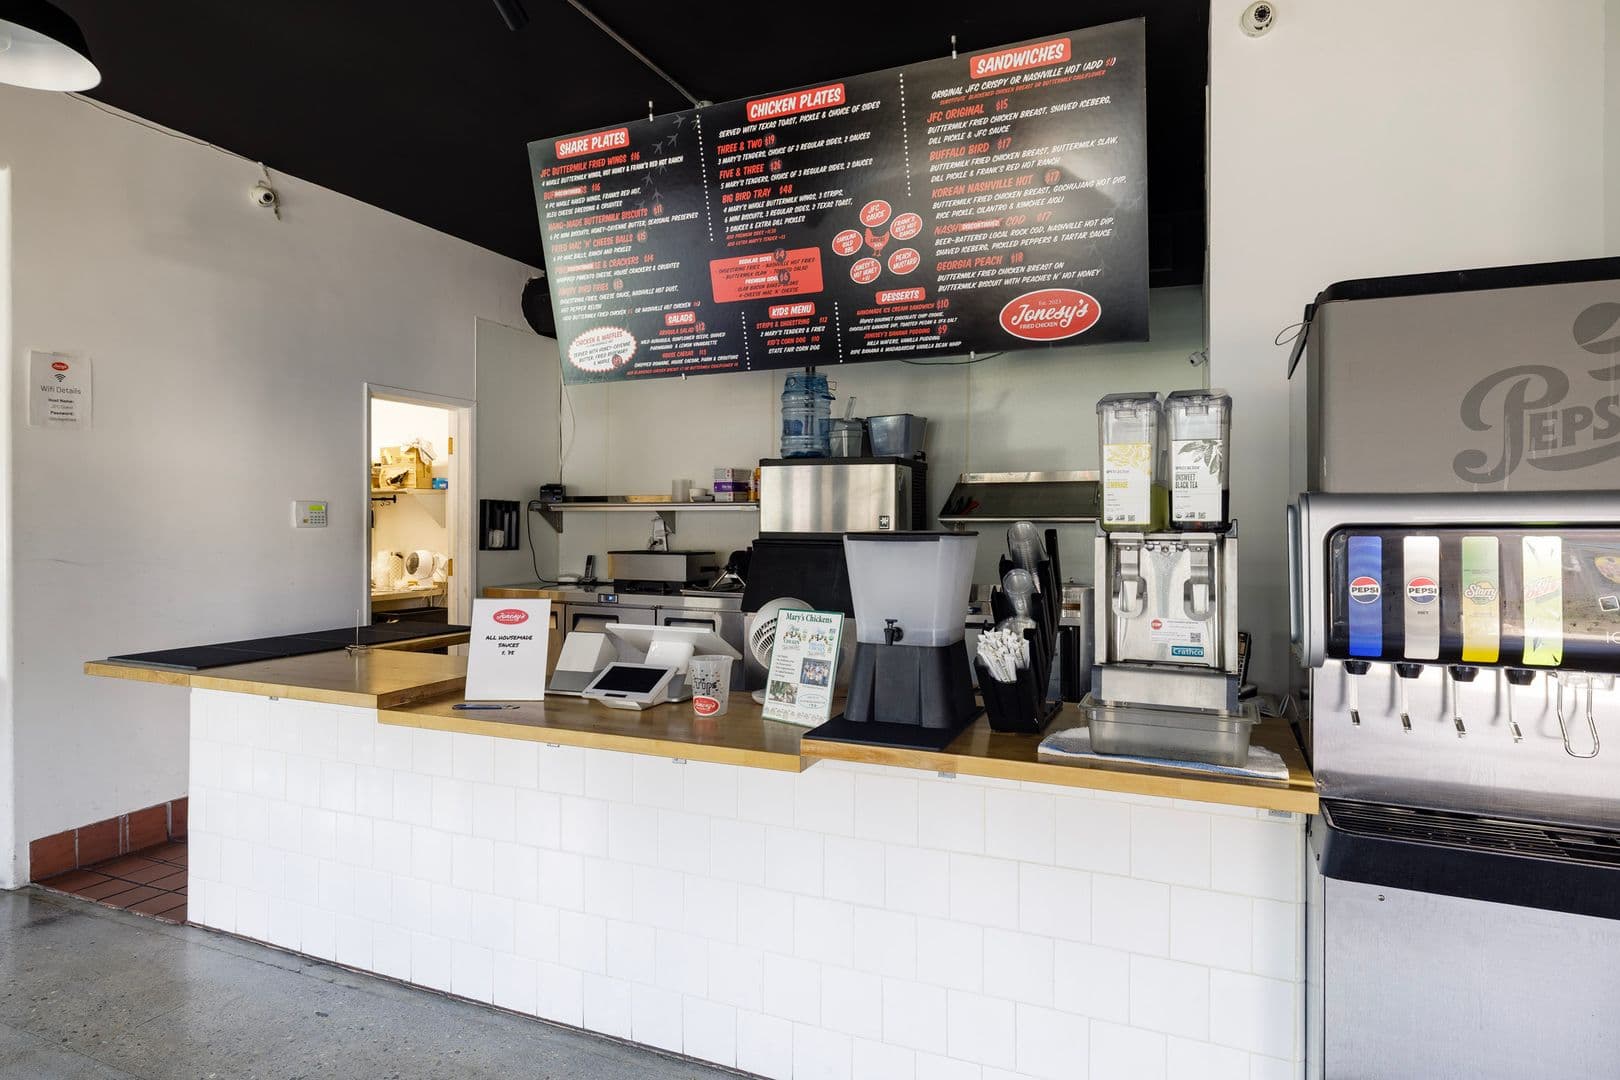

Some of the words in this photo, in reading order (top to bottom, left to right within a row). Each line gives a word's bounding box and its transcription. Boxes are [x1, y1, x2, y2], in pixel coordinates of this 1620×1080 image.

[977, 43, 1064, 74] SANDWICHES
[931, 86, 962, 99] ORIGINAL
[965, 83, 979, 93] JFC
[981, 78, 1008, 90] CRISPY
[1010, 75, 1019, 84] OR
[1022, 67, 1062, 82] NASHVILLE
[1064, 64, 1080, 74] HOT
[1083, 60, 1103, 71] (ADD
[750, 96, 797, 118] CHICKEN
[799, 87, 841, 109] PLATES
[927, 111, 943, 123] JFC
[945, 104, 984, 120] ORIGINAL
[996, 99, 1008, 111] $15
[718, 128, 740, 138] SERVED
[742, 124, 756, 133] WITH
[758, 121, 776, 130] TEXAS
[778, 117, 797, 127] TOAST,
[799, 112, 820, 123] PICKLE
[822, 111, 826, 119] &
[828, 107, 849, 117] CHOICE
[851, 105, 859, 113] OF
[861, 101, 880, 111] SIDES
[927, 120, 967, 134] BUTTERMILK
[968, 117, 989, 127] FRIED
[990, 112, 1018, 124] CHICKEN
[1019, 107, 1047, 118] BREAST,
[1050, 101, 1078, 113] SHAVED
[1080, 96, 1111, 108] ICEBERG,
[559, 138, 589, 155] SHARE
[591, 131, 626, 149] PLATES
[717, 143, 737, 154] THREE
[739, 141, 744, 150] &
[747, 138, 762, 149] TWO
[764, 134, 775, 145] $19
[928, 136, 942, 145] DILL
[943, 132, 965, 142] PICKLE
[967, 131, 972, 139] &
[974, 129, 986, 137] JFC
[988, 125, 1010, 135] SAUCE
[929, 146, 965, 160] BUFFALO
[968, 142, 990, 154] BIRD
[997, 137, 1011, 149] $17
[930, 159, 969, 172] BUTTERMILK
[971, 156, 990, 165] FRIED
[992, 151, 1020, 162] CHICKEN
[1022, 147, 1049, 158] BREAST,
[1052, 139, 1095, 153] BUTTERMILK
[1097, 136, 1119, 146] SLAW,
[539, 168, 550, 177] JFC
[551, 162, 587, 175] BUTTERMILK
[588, 158, 606, 168] FRIED
[607, 154, 627, 165] WINGS
[719, 169, 734, 179] FIVE
[735, 168, 740, 176] &
[743, 164, 764, 175] THREE
[930, 174, 944, 183] DILL
[945, 171, 968, 180] PICKLE
[976, 165, 1004, 176] FRANK'S
[1006, 163, 1020, 171] RED
[1022, 160, 1036, 169] HOT
[1038, 157, 1061, 167] RANCH
[722, 193, 734, 203] BIG
[735, 190, 751, 201] BIRD
[753, 187, 771, 198] TRAY
[779, 184, 792, 194] $48
[931, 185, 964, 198] KOREAN
[967, 178, 1012, 193] NASHVILLE
[1015, 175, 1034, 186] HOT
[932, 197, 972, 209] BUTTERMILK
[973, 194, 992, 203] FRIED
[994, 190, 1022, 201] CHICKEN
[1023, 186, 1051, 197] BREAST,
[1096, 178, 1111, 187] HOT
[1113, 175, 1128, 184] DIP,
[936, 211, 949, 219] RICE
[976, 203, 1007, 214] CILANTRO
[934, 233, 988, 246] BEER-BATTERED
[989, 230, 1008, 239] LOCAL
[1011, 228, 1028, 237] ROCK
[1030, 226, 1044, 234] COD,
[1047, 221, 1082, 232] NASHVILLE
[1085, 219, 1099, 228] HOT
[1101, 217, 1114, 226] DIP,
[936, 247, 959, 255] SHAVED
[961, 243, 989, 253] ICEBERG,
[991, 240, 1019, 249] PICKLED
[1021, 236, 1051, 246] PEPPERS
[1061, 232, 1087, 241] TARTAR
[1089, 229, 1112, 238] SAUCE
[936, 259, 972, 271] GEORGIA
[974, 255, 1003, 267] PEACH
[1011, 252, 1024, 263] $18
[937, 271, 976, 281] BUTTERMILK
[977, 269, 996, 277] FRIED
[998, 266, 1025, 275] CHICKEN
[1027, 263, 1053, 272] BREAST
[938, 282, 976, 292] BUTTERMILK
[978, 279, 1001, 288] BISCUIT
[1003, 277, 1019, 285] WITH
[1022, 274, 1051, 283] PEACHES
[1078, 269, 1101, 278] HONEY
[881, 291, 919, 301] DESSERTS
[667, 314, 693, 323] SALADS
[771, 307, 788, 315] KIDS
[790, 304, 812, 314] MENU
[1011, 299, 1089, 327] Jonesy's
[56, 386, 81, 394] Details
[1190, 481, 1198, 489] TEA
[1464, 584, 1497, 600] Starry
[805, 614, 833, 623] Chickens
[1173, 646, 1203, 655] Crathco
